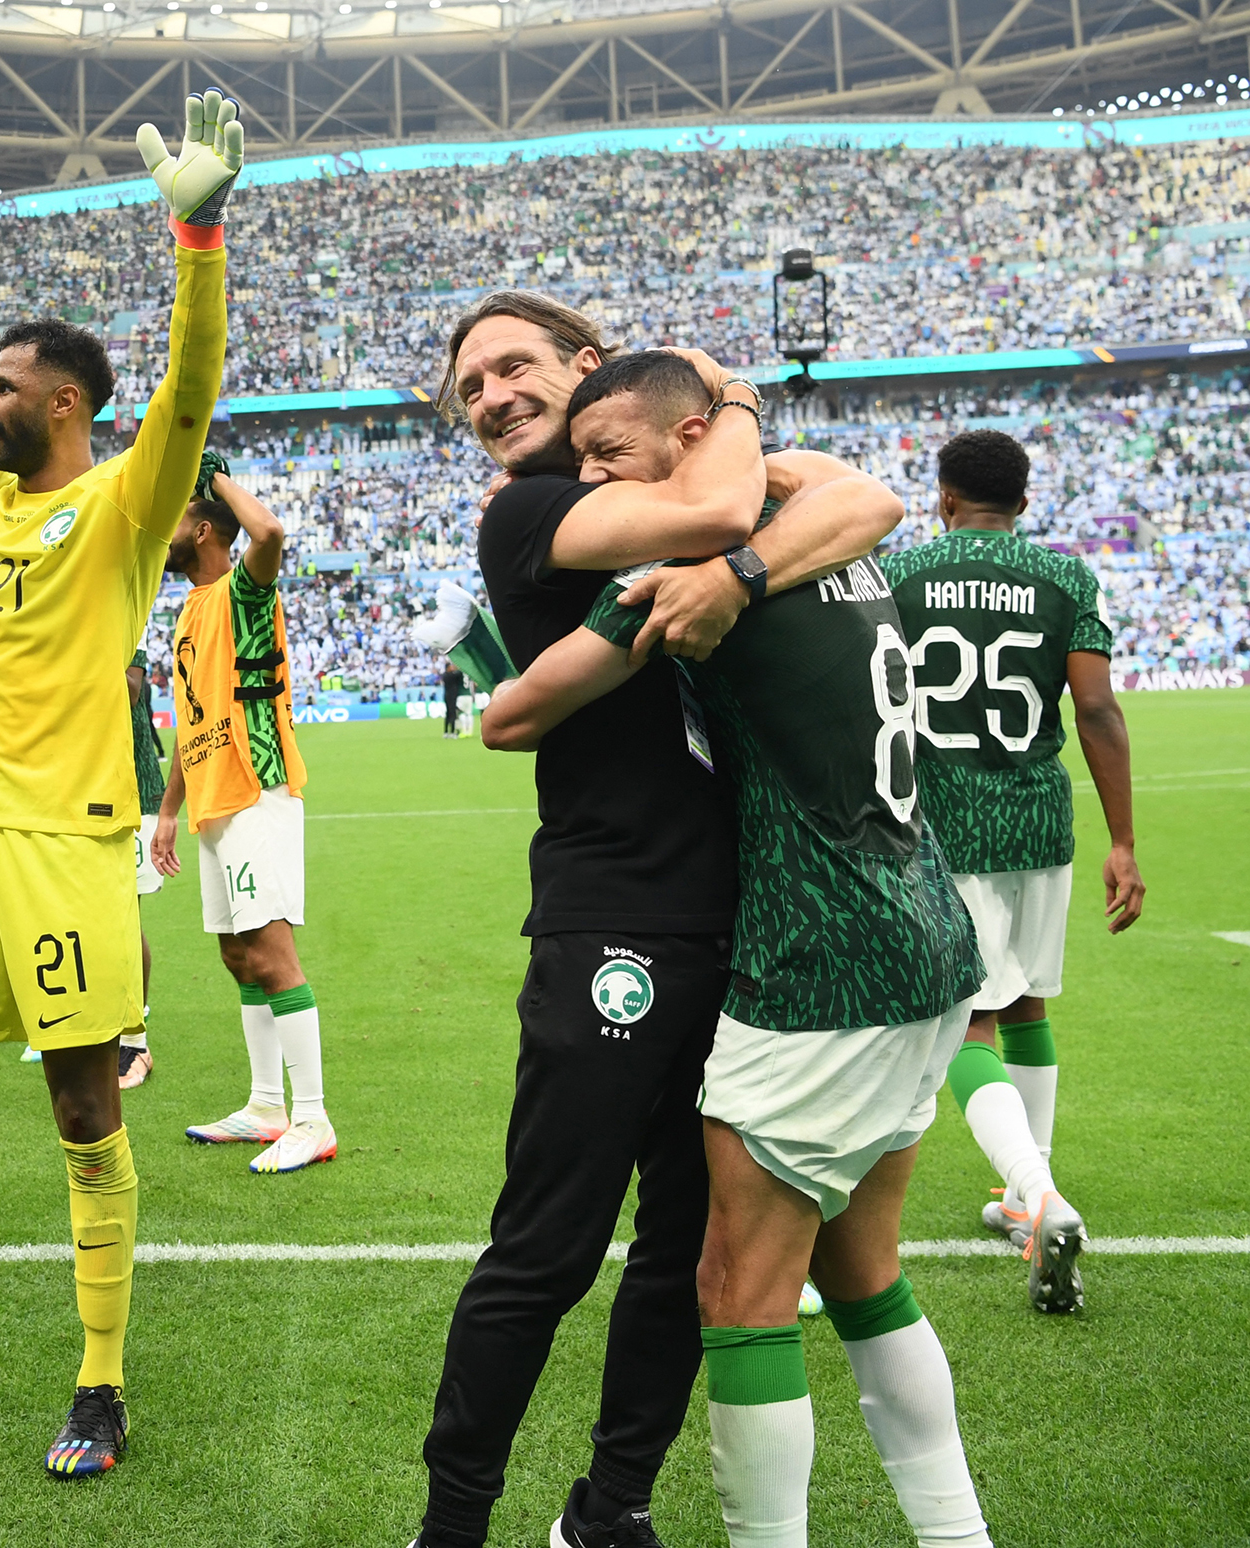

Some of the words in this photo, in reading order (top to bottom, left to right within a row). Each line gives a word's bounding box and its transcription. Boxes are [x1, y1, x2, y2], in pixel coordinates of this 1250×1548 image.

[43, 542, 65, 551] KSA
[925, 580, 1035, 615] HAITHAM
[908, 626, 1044, 752] 25
[1135, 668, 1245, 692] AIRWAYS
[292, 705, 350, 724] vivo
[870, 623, 917, 824] 8
[226, 861, 257, 902] 14
[34, 931, 87, 996] 21
[603, 946, 654, 967] السعودية
[624, 999, 641, 1008] SAFF
[600, 1026, 631, 1041] KSA
